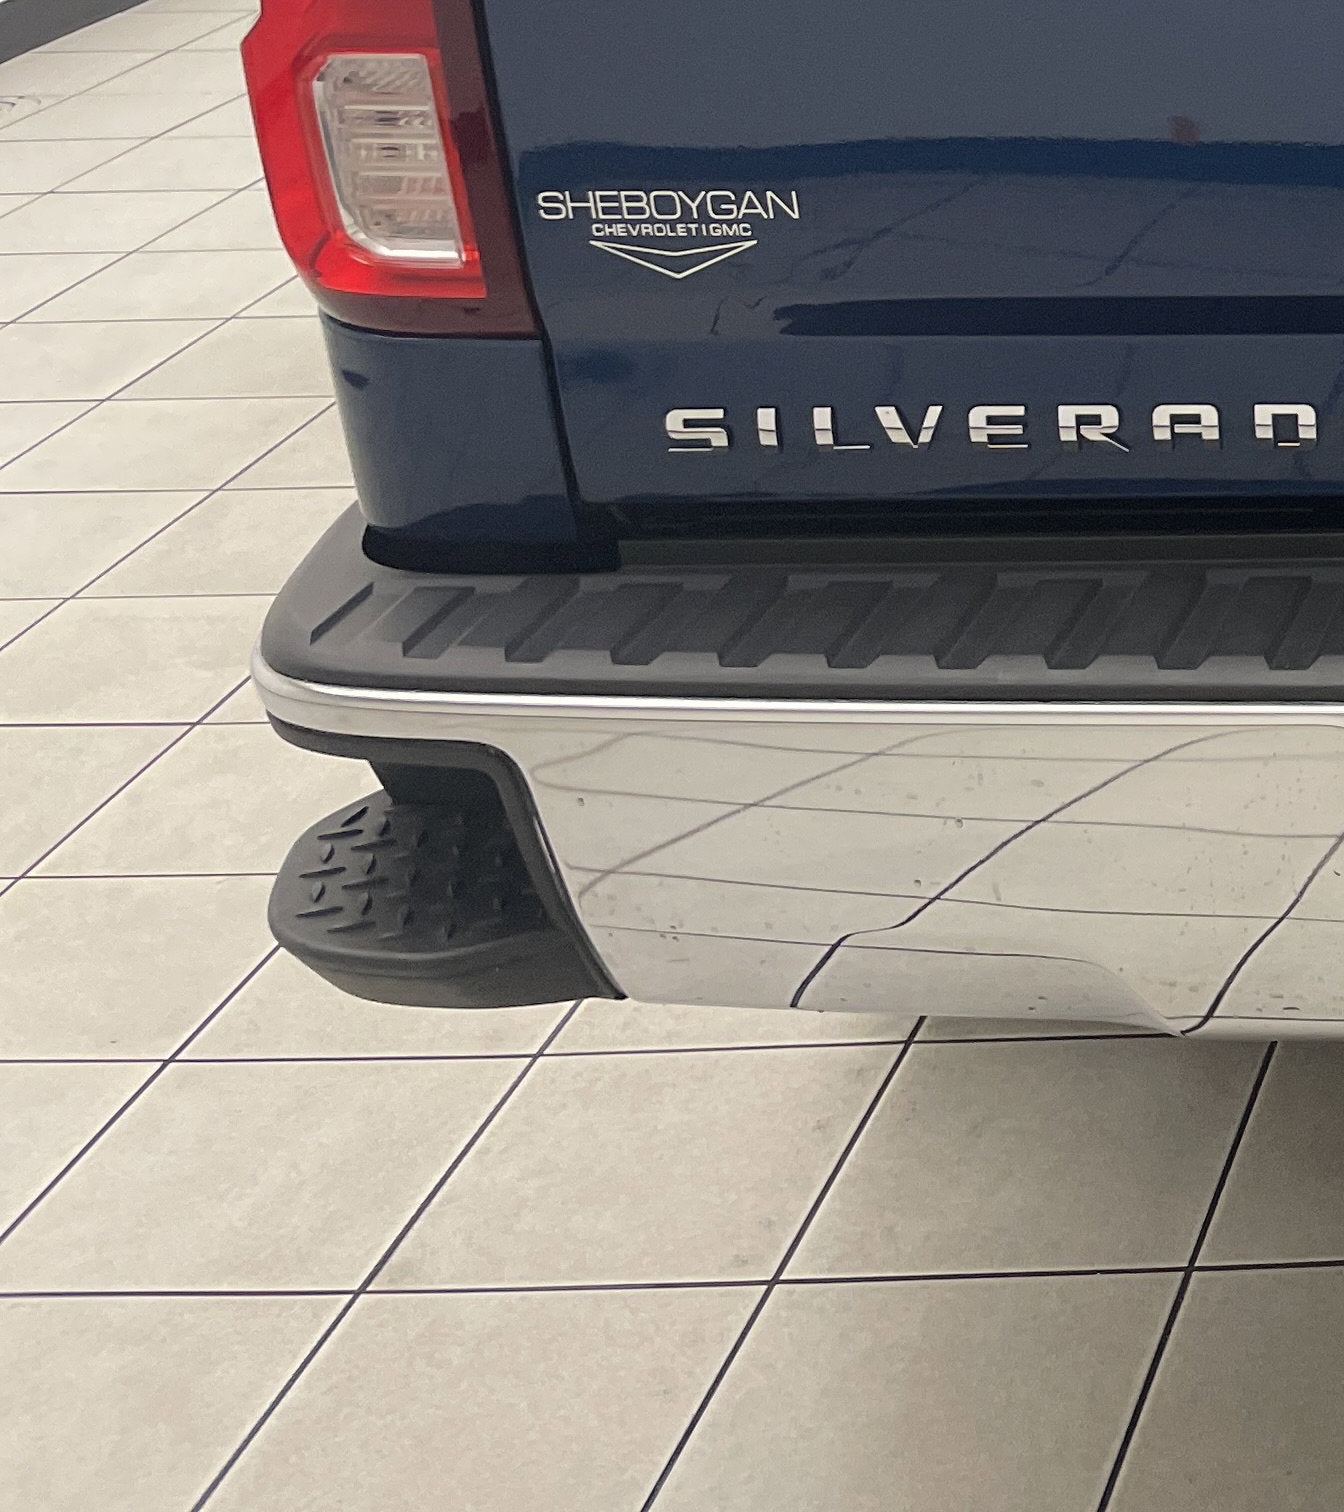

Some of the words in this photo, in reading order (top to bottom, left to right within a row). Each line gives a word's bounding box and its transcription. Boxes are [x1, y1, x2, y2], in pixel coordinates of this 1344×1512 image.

[537, 190, 800, 220] SHEBOYGAN
[591, 223, 699, 237] CHEVROLET
[709, 223, 752, 237] GMC
